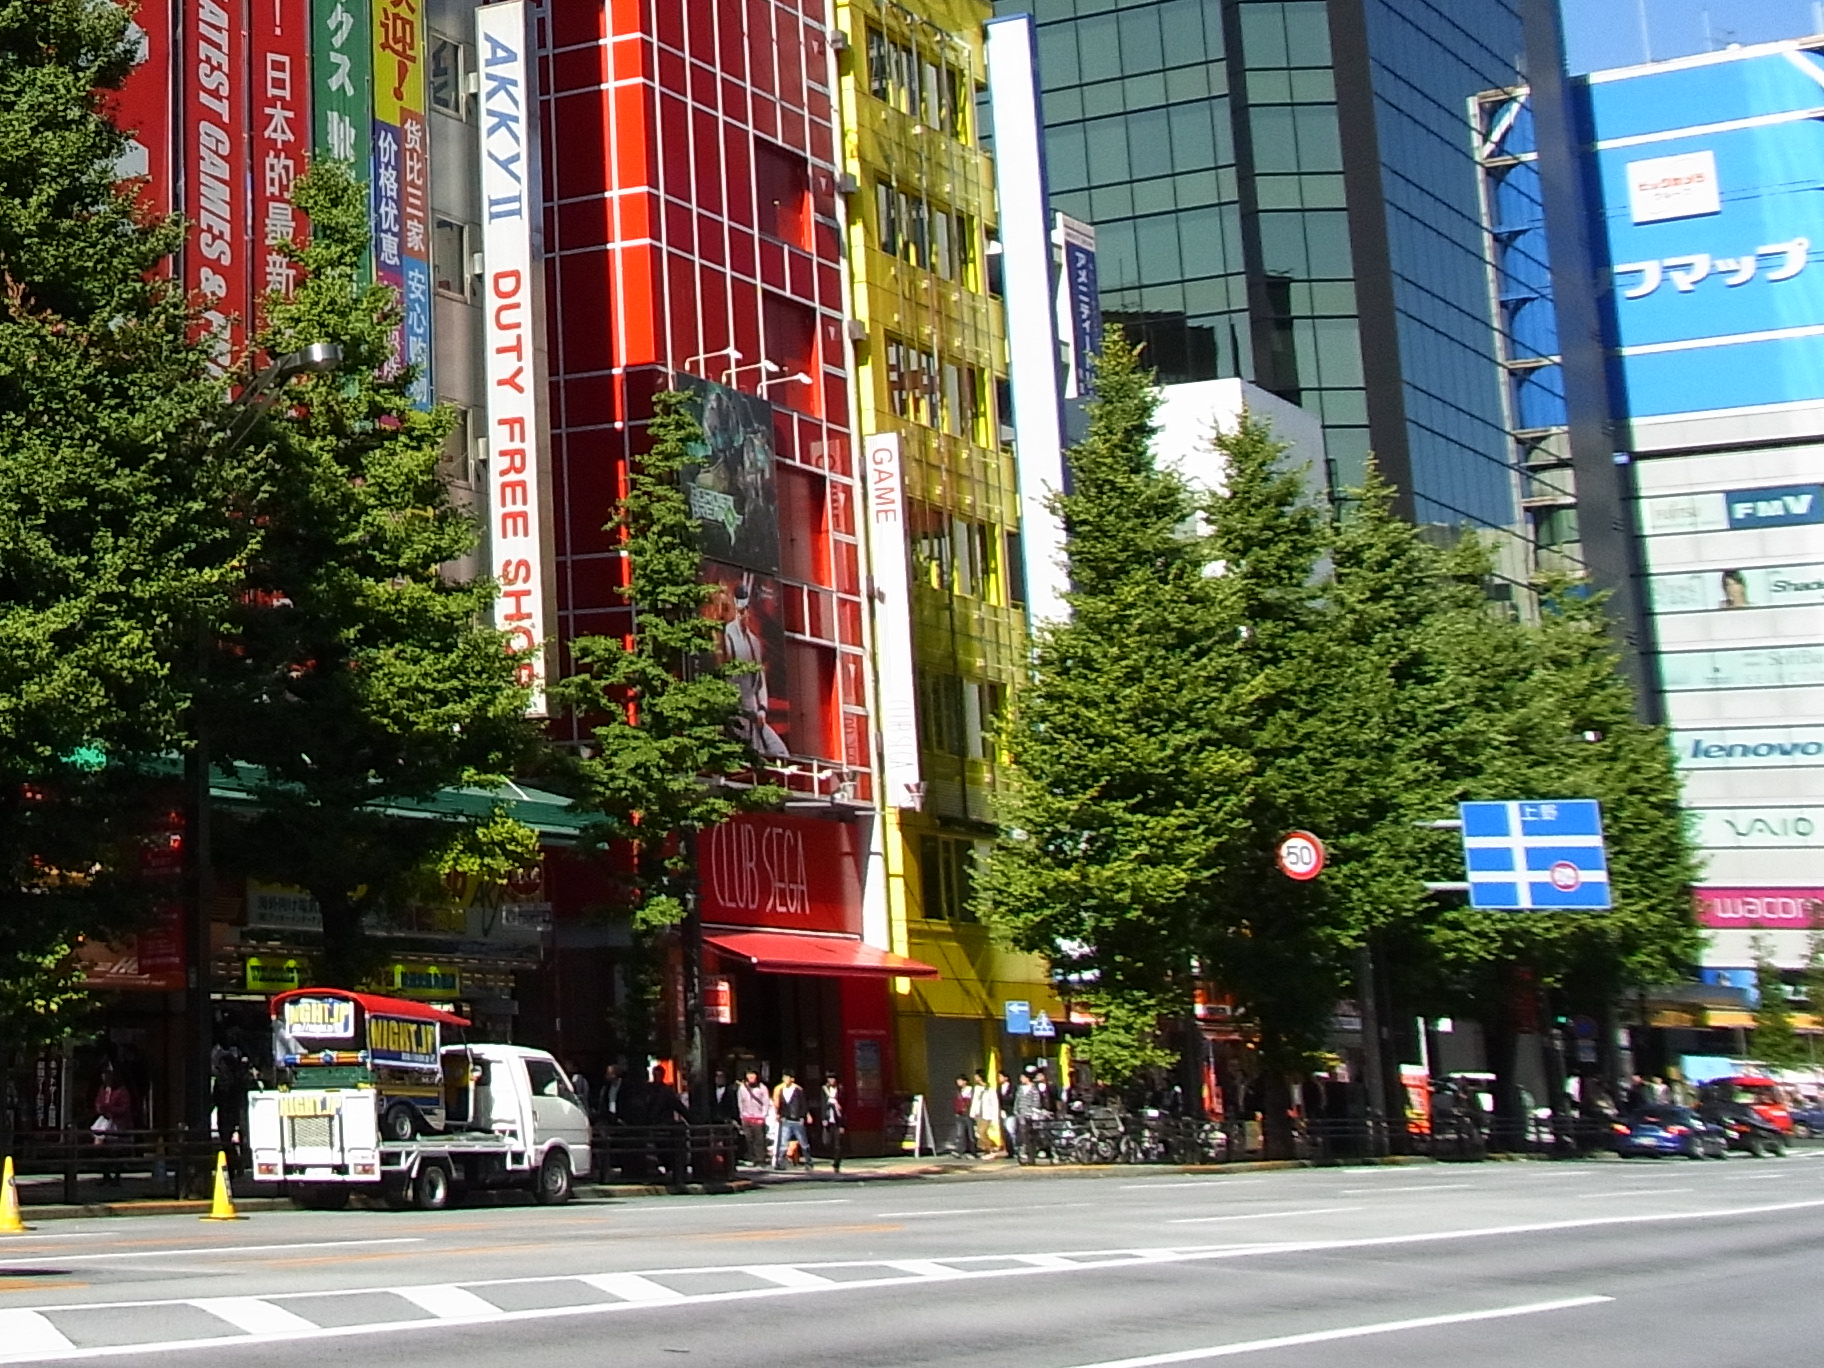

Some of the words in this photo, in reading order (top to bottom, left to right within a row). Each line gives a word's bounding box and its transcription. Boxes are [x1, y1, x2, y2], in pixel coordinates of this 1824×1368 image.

[482, 34, 524, 183] AKKY
[198, 119, 234, 268] GAMES
[377, 130, 401, 267] 价格优惠
[402, 118, 425, 252] 货比三家
[200, 266, 227, 298] &
[1616, 237, 1810, 300] フマップ
[492, 270, 525, 395] DUTY
[497, 416, 529, 539] FREE
[872, 446, 897, 530] GAME
[1732, 494, 1813, 519] FMV
[1691, 738, 1823, 760] lenovo
[1521, 804, 1559, 821] 上野
[1724, 816, 1815, 838] VAIO
[712, 822, 758, 909] CLUB
[763, 827, 810, 915] SEGA
[1286, 845, 1313, 866] 50
